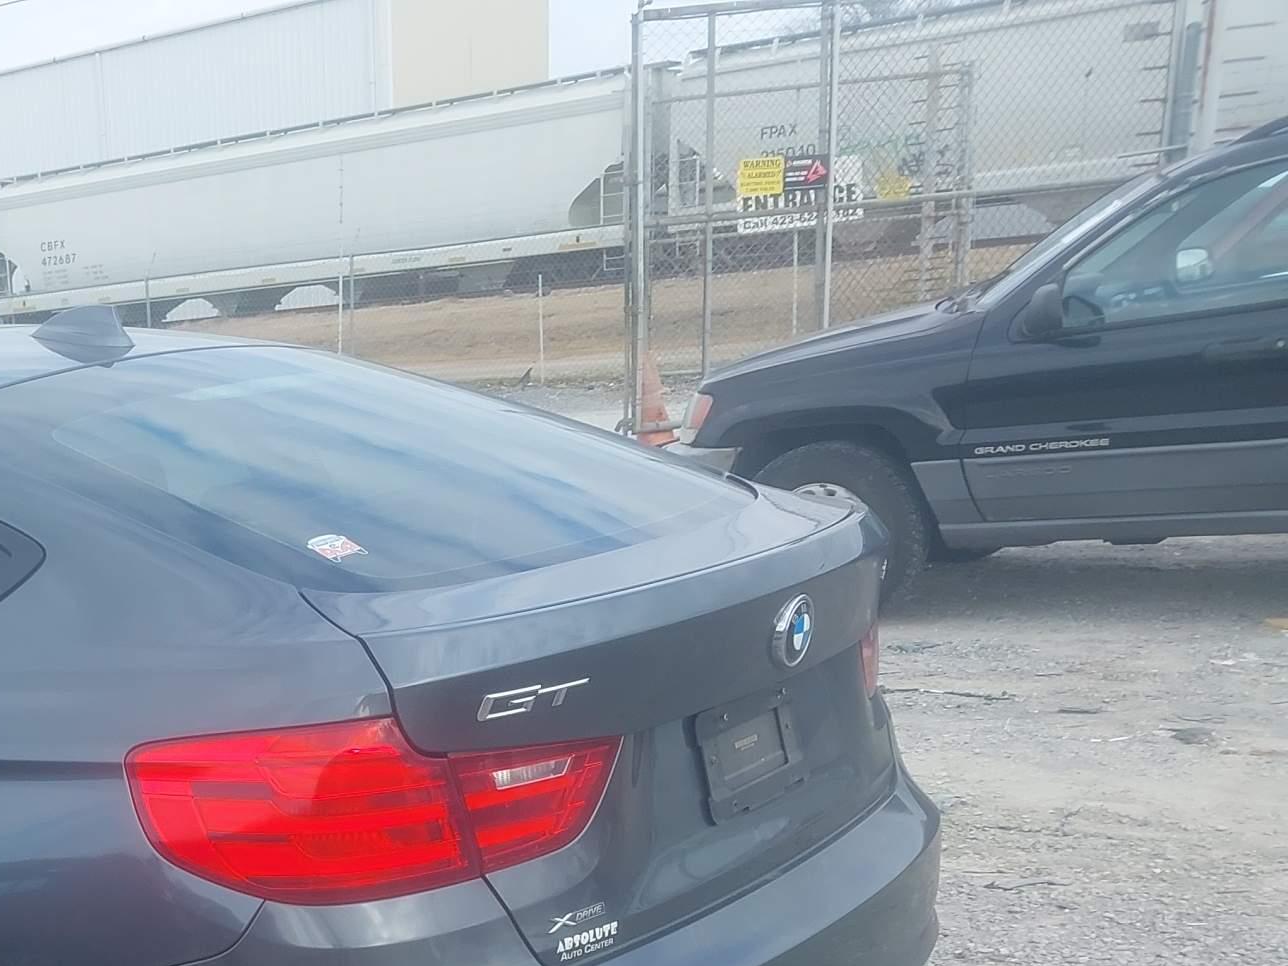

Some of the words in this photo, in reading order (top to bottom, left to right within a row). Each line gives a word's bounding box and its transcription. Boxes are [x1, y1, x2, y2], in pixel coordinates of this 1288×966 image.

[760, 123, 798, 140] FPAX
[743, 158, 781, 169] WARNING
[742, 183, 859, 211] ENTRACE
[974, 444, 1025, 455] GRAND
[1029, 438, 1110, 451] CHEROKEE
[477, 678, 590, 721] GT
[556, 920, 618, 954] ABSOLUTE
